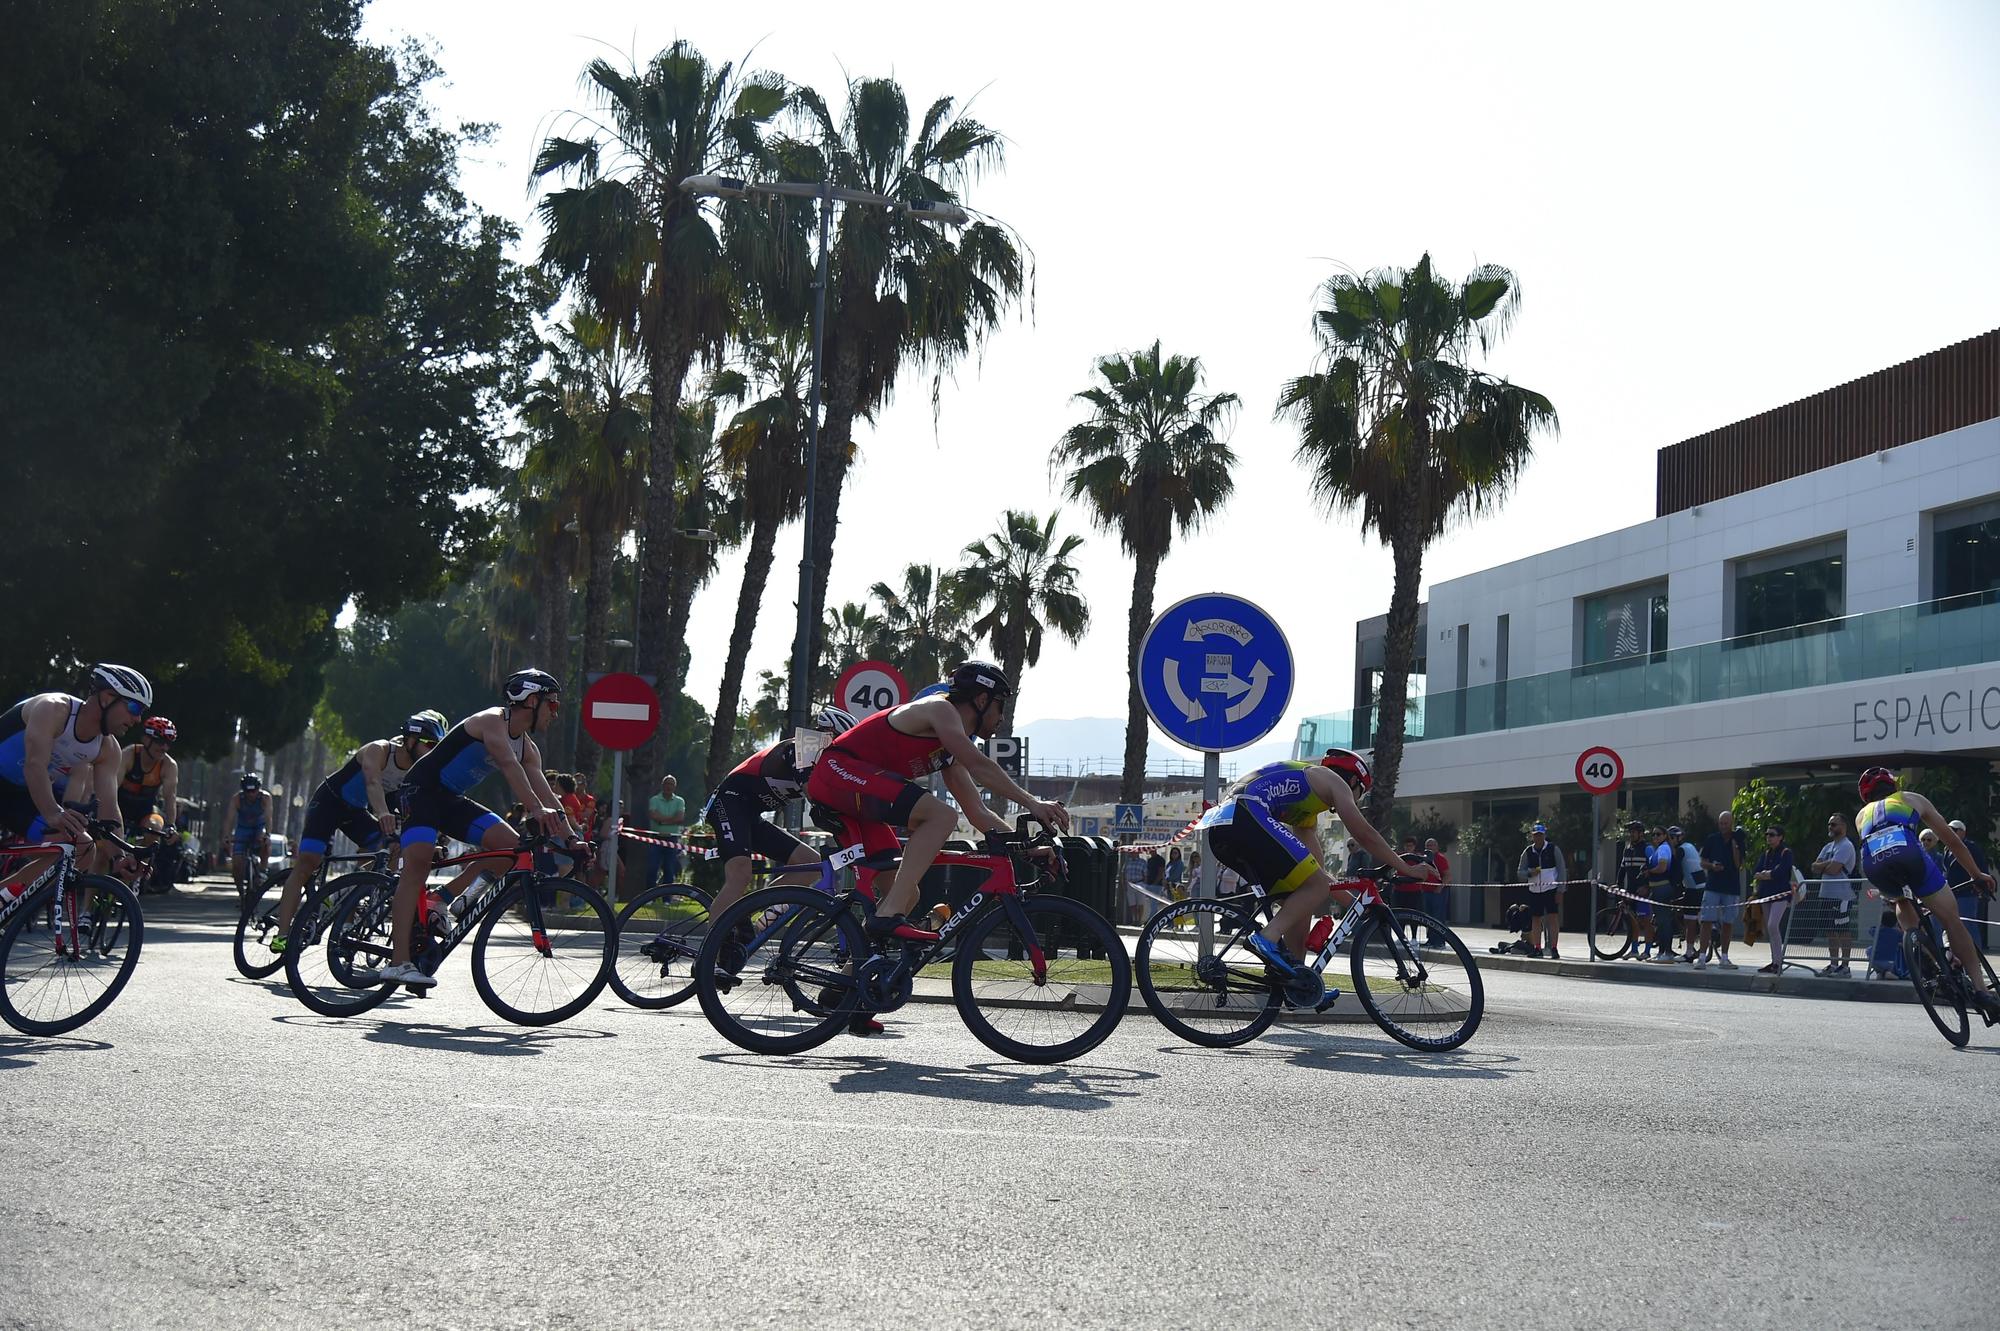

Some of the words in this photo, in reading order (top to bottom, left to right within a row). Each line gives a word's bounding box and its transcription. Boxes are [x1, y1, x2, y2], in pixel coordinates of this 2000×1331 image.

[851, 685, 894, 711] 40
[1853, 686, 2000, 743] ESPACIO
[989, 738, 1018, 764] P
[827, 758, 868, 786] Cartagena
[1585, 763, 1614, 779] 40
[1137, 832, 1172, 841] TRADA
[1267, 816, 1306, 849] aquario
[1877, 834, 1896, 847] 72
[840, 850, 855, 864] 30
[0, 865, 56, 922] nondale
[444, 876, 507, 948] SPECIALIZED
[1146, 903, 1239, 948] BONTRAGER
[1313, 888, 1376, 975] TREK
